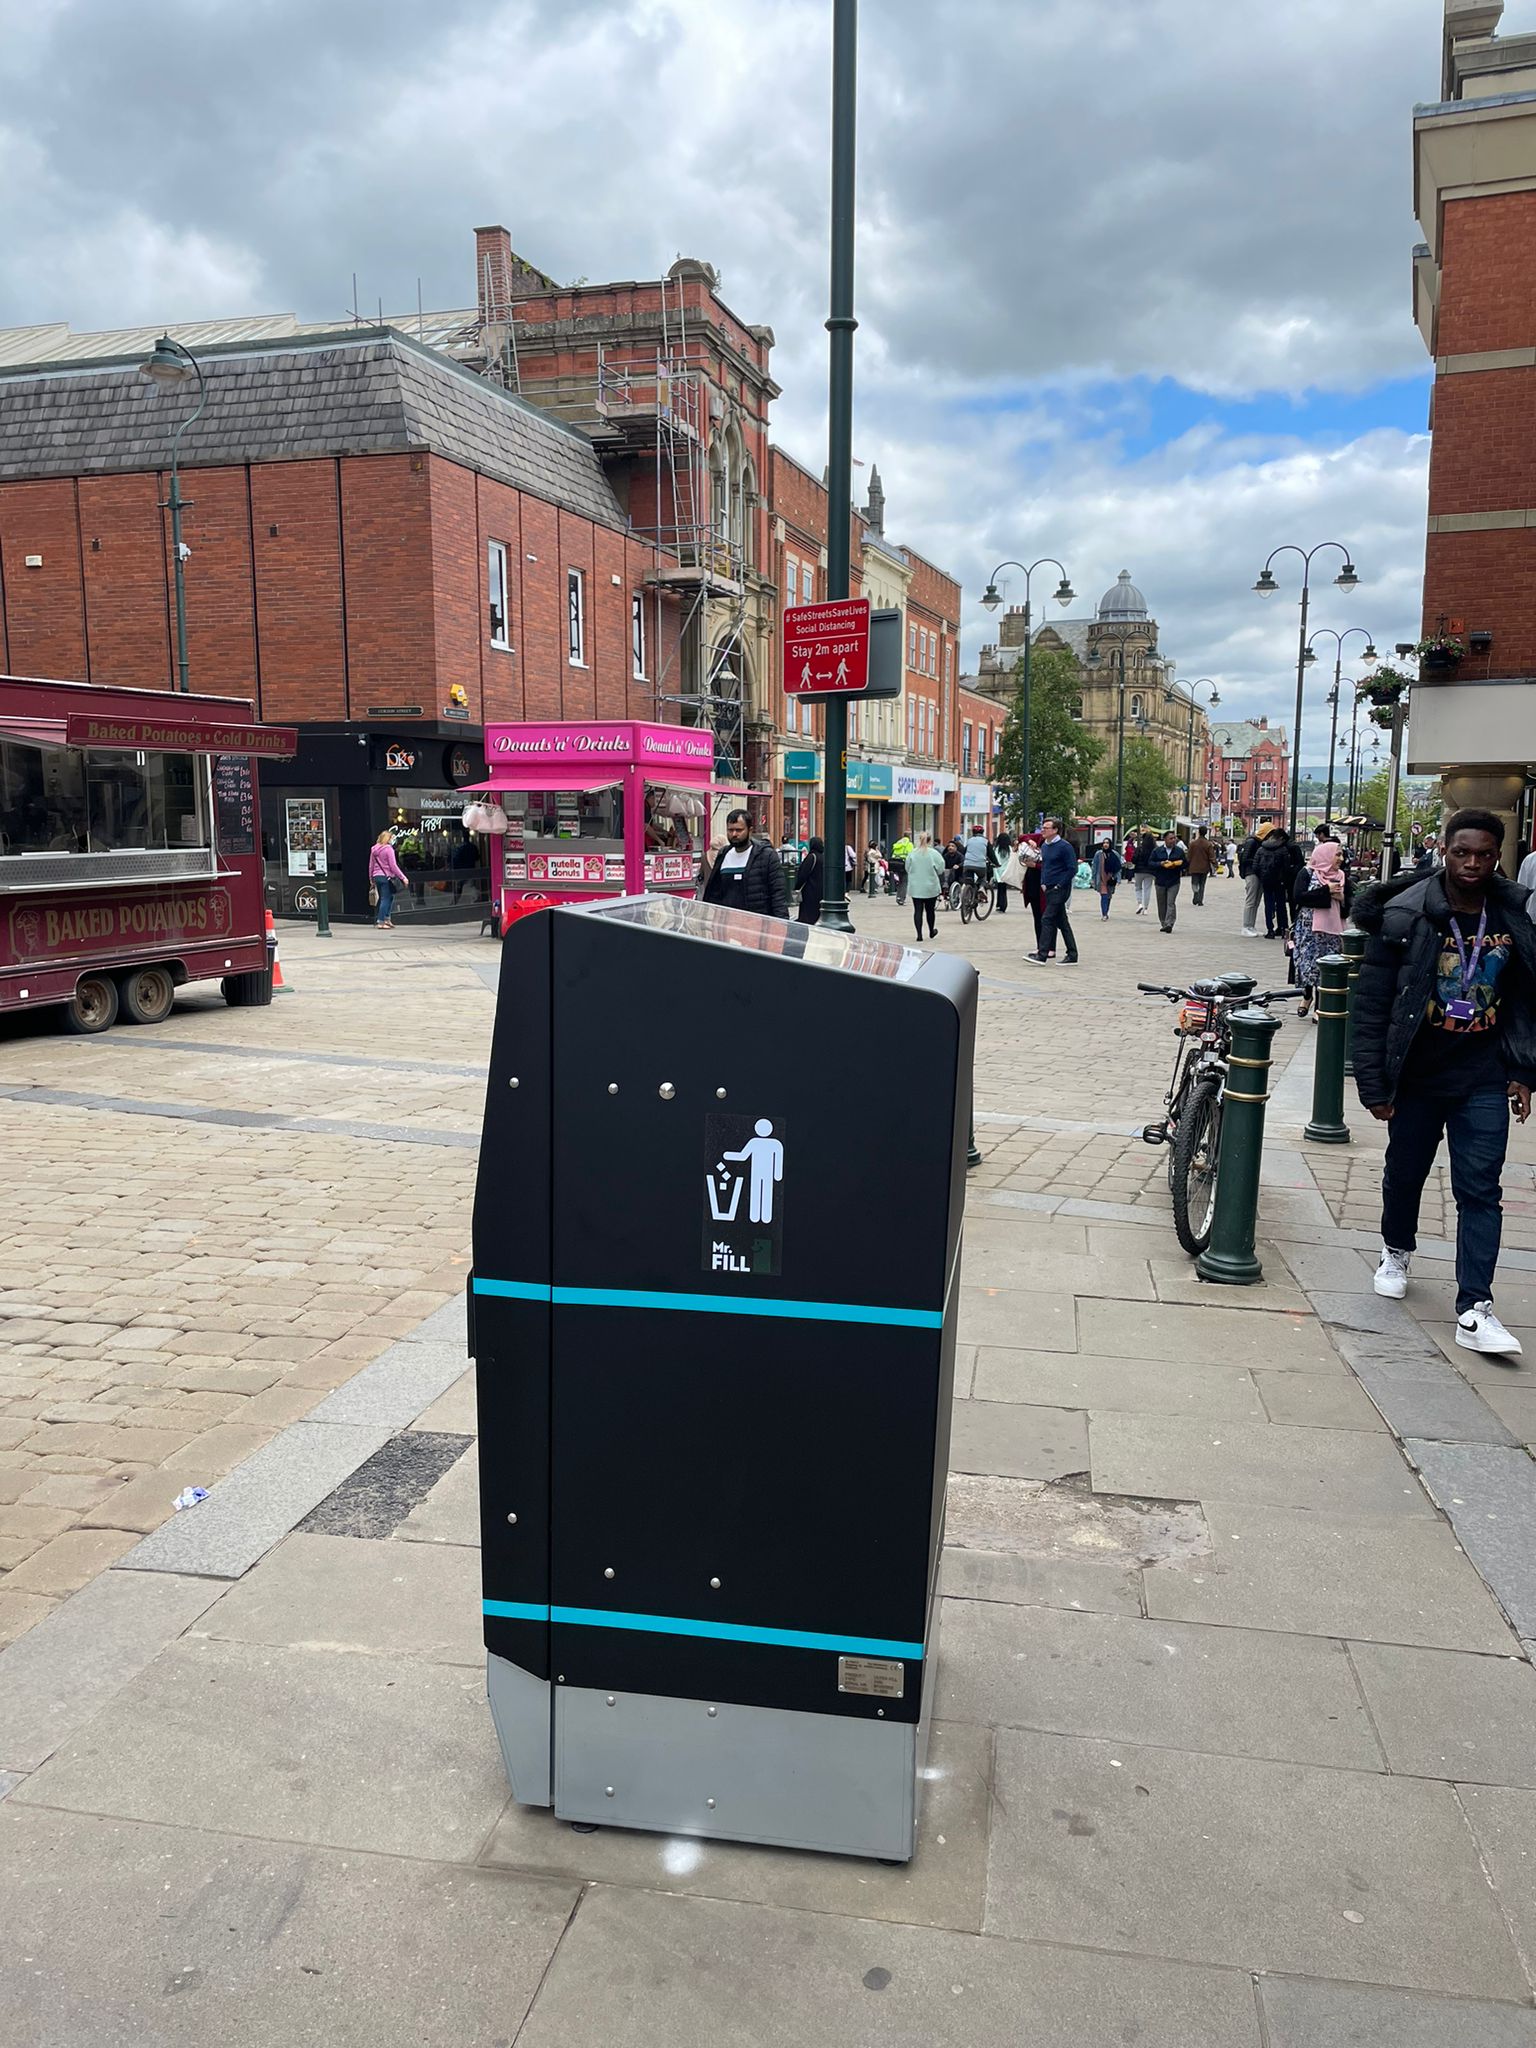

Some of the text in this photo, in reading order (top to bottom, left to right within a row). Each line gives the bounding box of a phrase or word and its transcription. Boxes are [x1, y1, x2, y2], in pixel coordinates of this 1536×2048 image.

[792, 606, 867, 622] SafeStreetsSaveLives
[796, 620, 856, 634] Social Distancing
[792, 640, 859, 659] Stay 2m apart
[87, 722, 287, 748] Baked Potatoes Cold Drinks
[572, 735, 631, 752] Drinks
[684, 740, 711, 757] Drinks
[421, 798, 445, 809] Kebabs
[446, 799, 463, 809] Done
[388, 825, 420, 845] Since
[551, 858, 581, 868] nutella
[552, 868, 580, 877] donuts
[45, 897, 207, 947] BAKED POTATOES
[712, 1240, 733, 1254] Mr.
[711, 1253, 751, 1272] FILL
